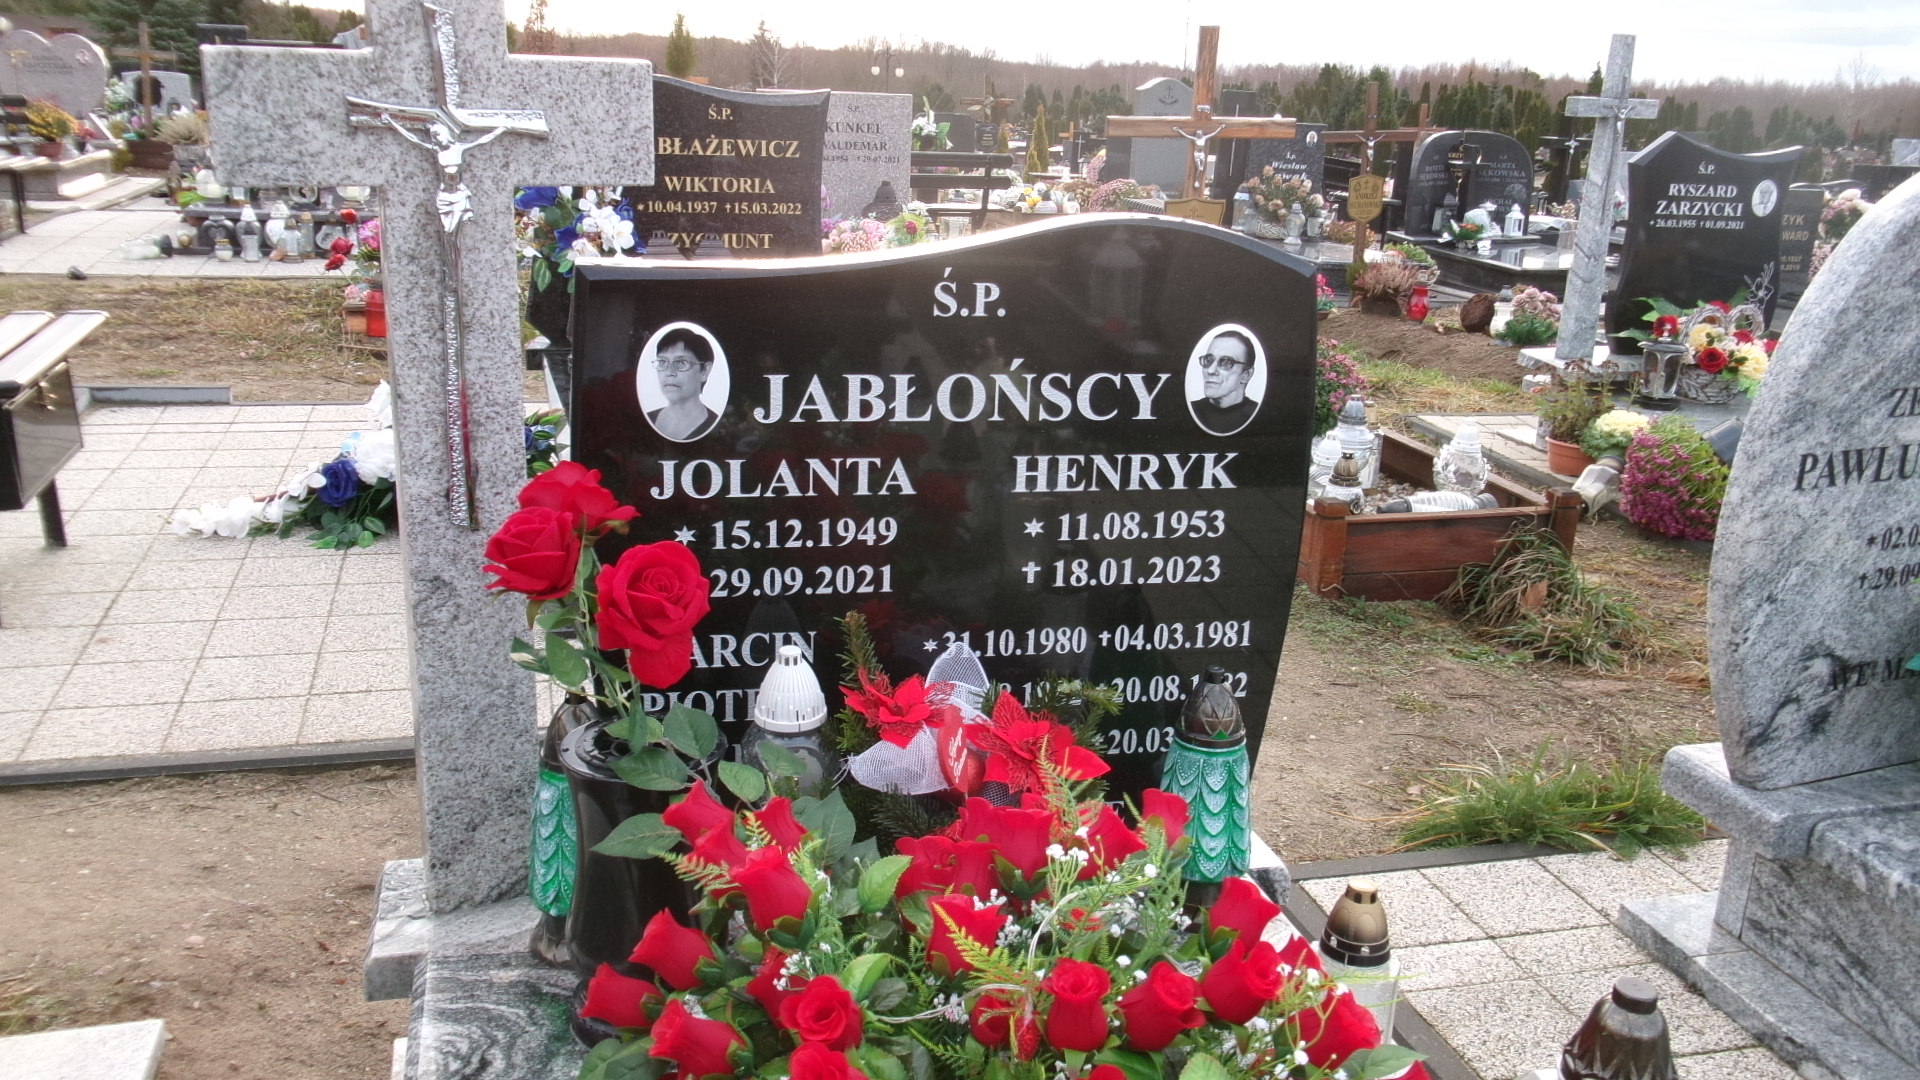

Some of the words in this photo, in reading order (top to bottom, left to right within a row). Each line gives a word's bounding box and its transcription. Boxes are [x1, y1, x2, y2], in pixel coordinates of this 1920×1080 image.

[708, 104, 734, 120] Ś.P.
[825, 122, 884, 133] KUNKEL
[658, 135, 800, 158] BŁAŻEWICZ
[663, 177, 776, 194] WIKTORIA
[1668, 183, 1737, 198] RYSZARD
[648, 201, 718, 213] 10.04.1937
[734, 202, 802, 215] 15.03.2022
[1655, 200, 1744, 216] ZARZYCKI
[667, 232, 774, 249] ZYUNT
[932, 268, 1007, 318] Ś.P.
[755, 358, 1171, 423] JABŁOŃSCY
[650, 456, 917, 501] JOLANTA
[1012, 451, 1239, 494] HENRYK
[711, 517, 898, 550] 15.12.1949
[1059, 510, 1226, 542] 11.08.1953
[709, 564, 893, 598] 29.09.2021
[1052, 556, 1222, 589] 18.01.2023
[689, 631, 817, 668] ARCIN
[1114, 620, 1250, 651] 04.03.1981
